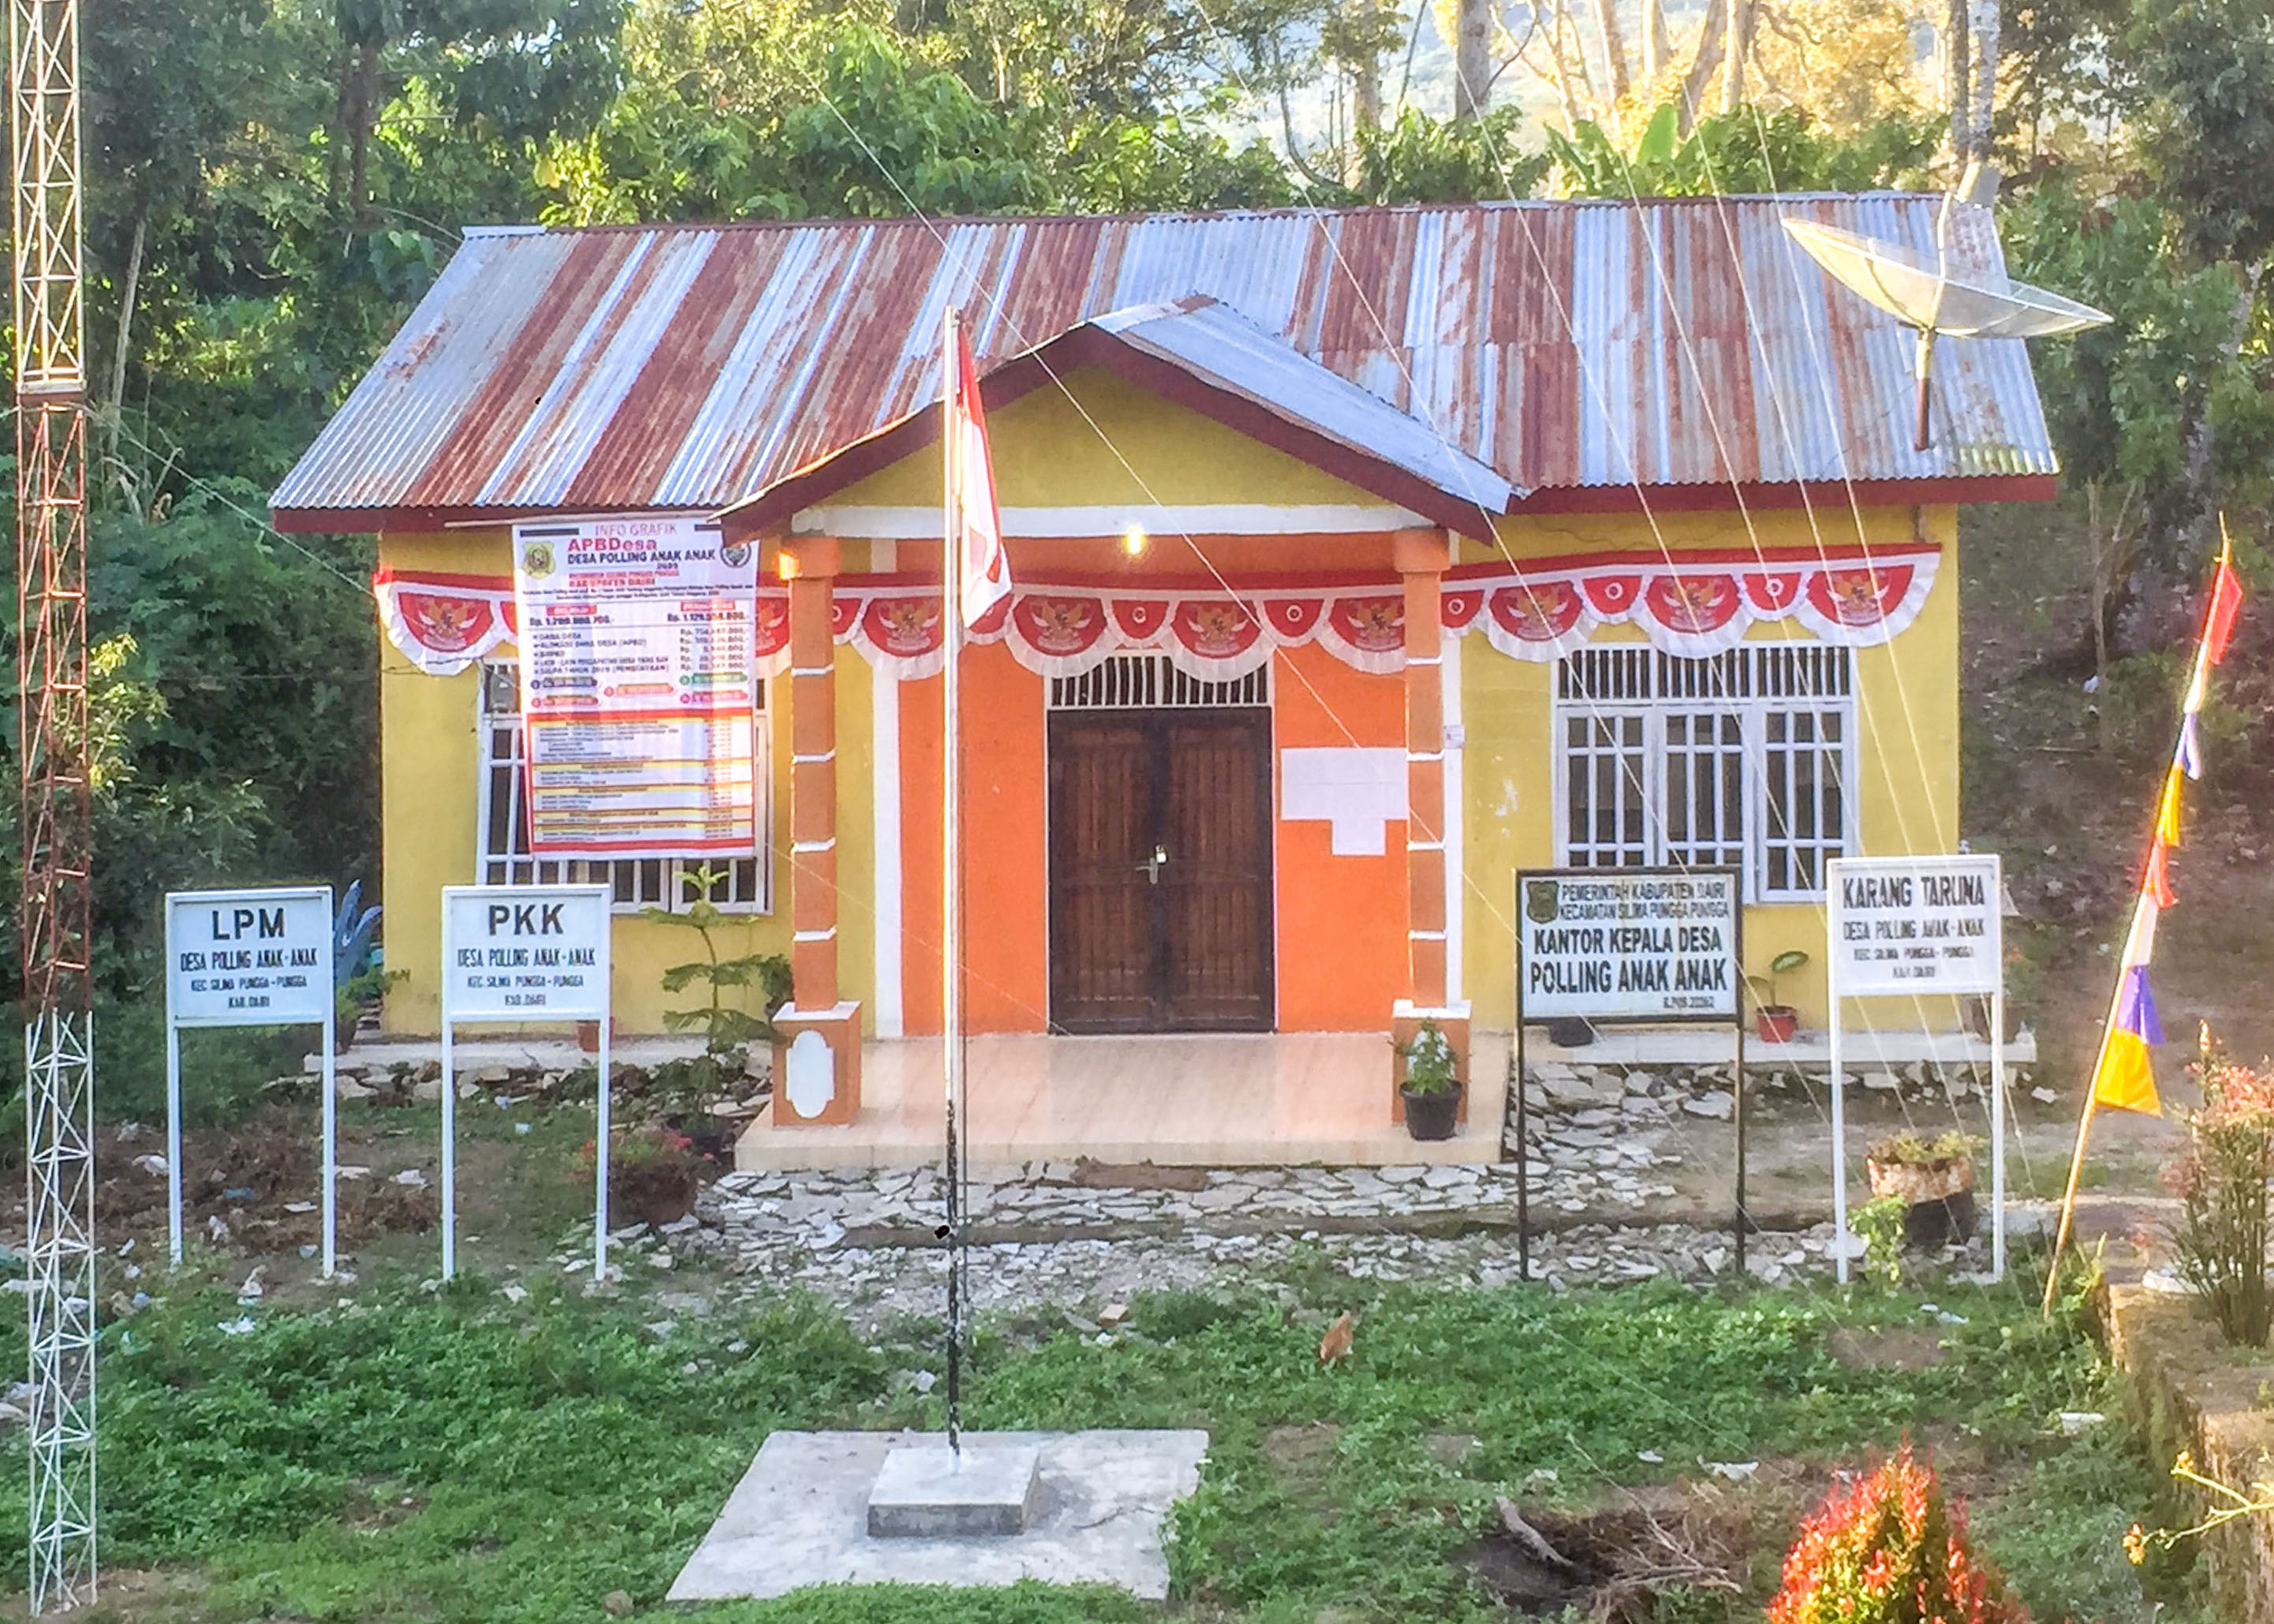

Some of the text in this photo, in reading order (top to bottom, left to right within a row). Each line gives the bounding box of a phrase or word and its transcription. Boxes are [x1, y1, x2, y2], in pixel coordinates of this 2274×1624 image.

[596, 522, 677, 536] INFO GRAFIK
[568, 537, 657, 551] APBDesa
[568, 549, 715, 565] DESA POLLING ANAK ANAK
[1563, 882, 1726, 901] PEMERINTAH KABUPATEN DAIRI
[1843, 875, 1985, 909] KARANG TARUNA
[488, 903, 565, 936] PKK
[1560, 903, 1616, 920] KECAMATAN
[212, 908, 285, 941] LPM
[1843, 921, 1870, 940] DESA
[1876, 920, 1916, 939] POLLING
[1534, 926, 1723, 954] KANTOR KEPALA DESA
[181, 952, 207, 972] DESA
[211, 950, 252, 970] POLLING
[457, 948, 484, 967] DESA
[489, 948, 528, 967] POLLING
[1530, 958, 1727, 994] POLLING ANAK ANAK
